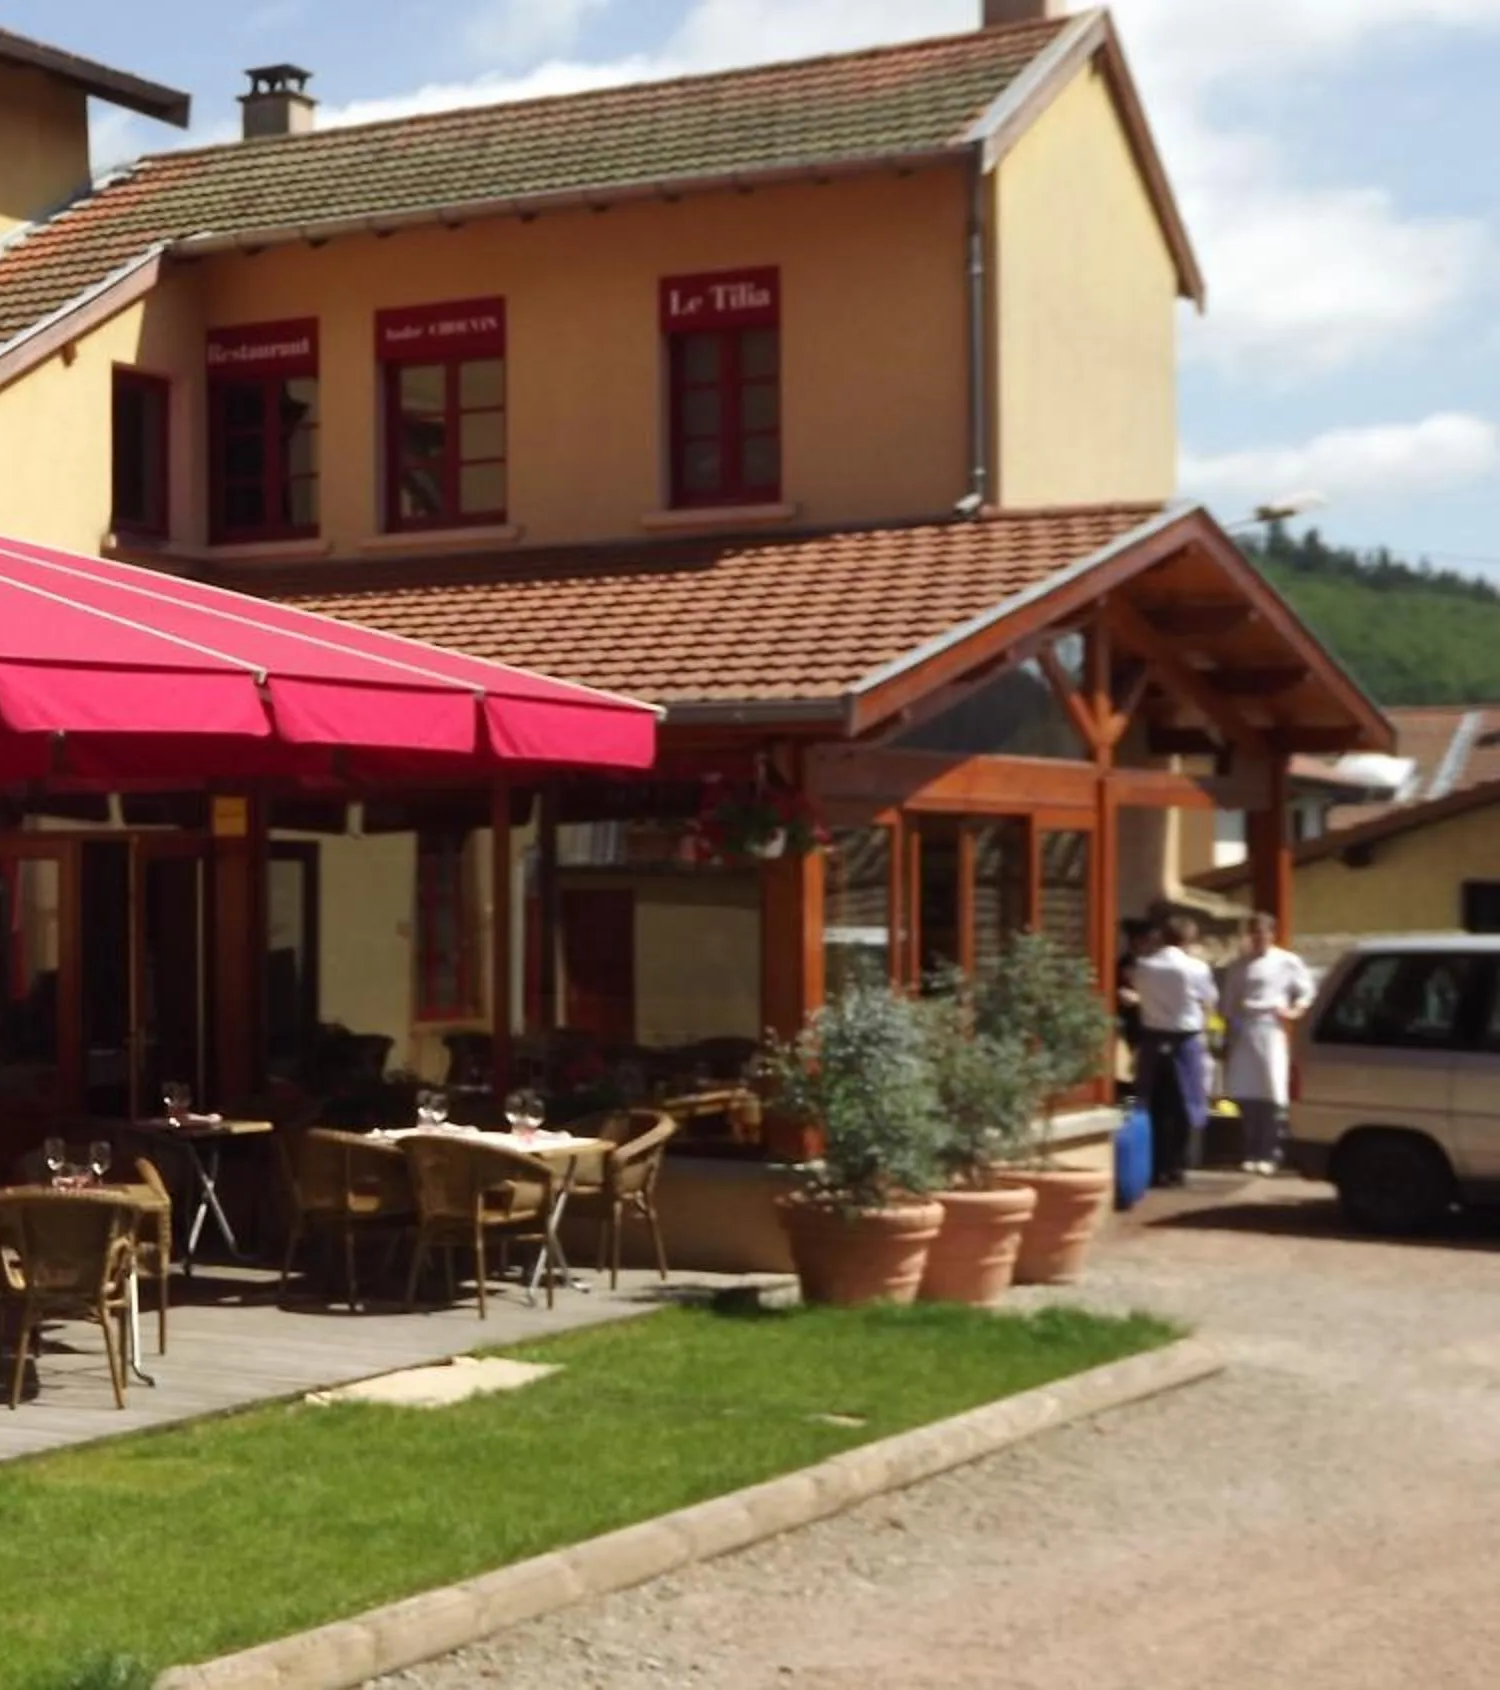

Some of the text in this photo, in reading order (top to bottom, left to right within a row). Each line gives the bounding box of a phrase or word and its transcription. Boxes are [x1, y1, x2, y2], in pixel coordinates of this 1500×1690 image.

[670, 282, 771, 315] Le Tilia
[207, 337, 310, 364] Restaurant
